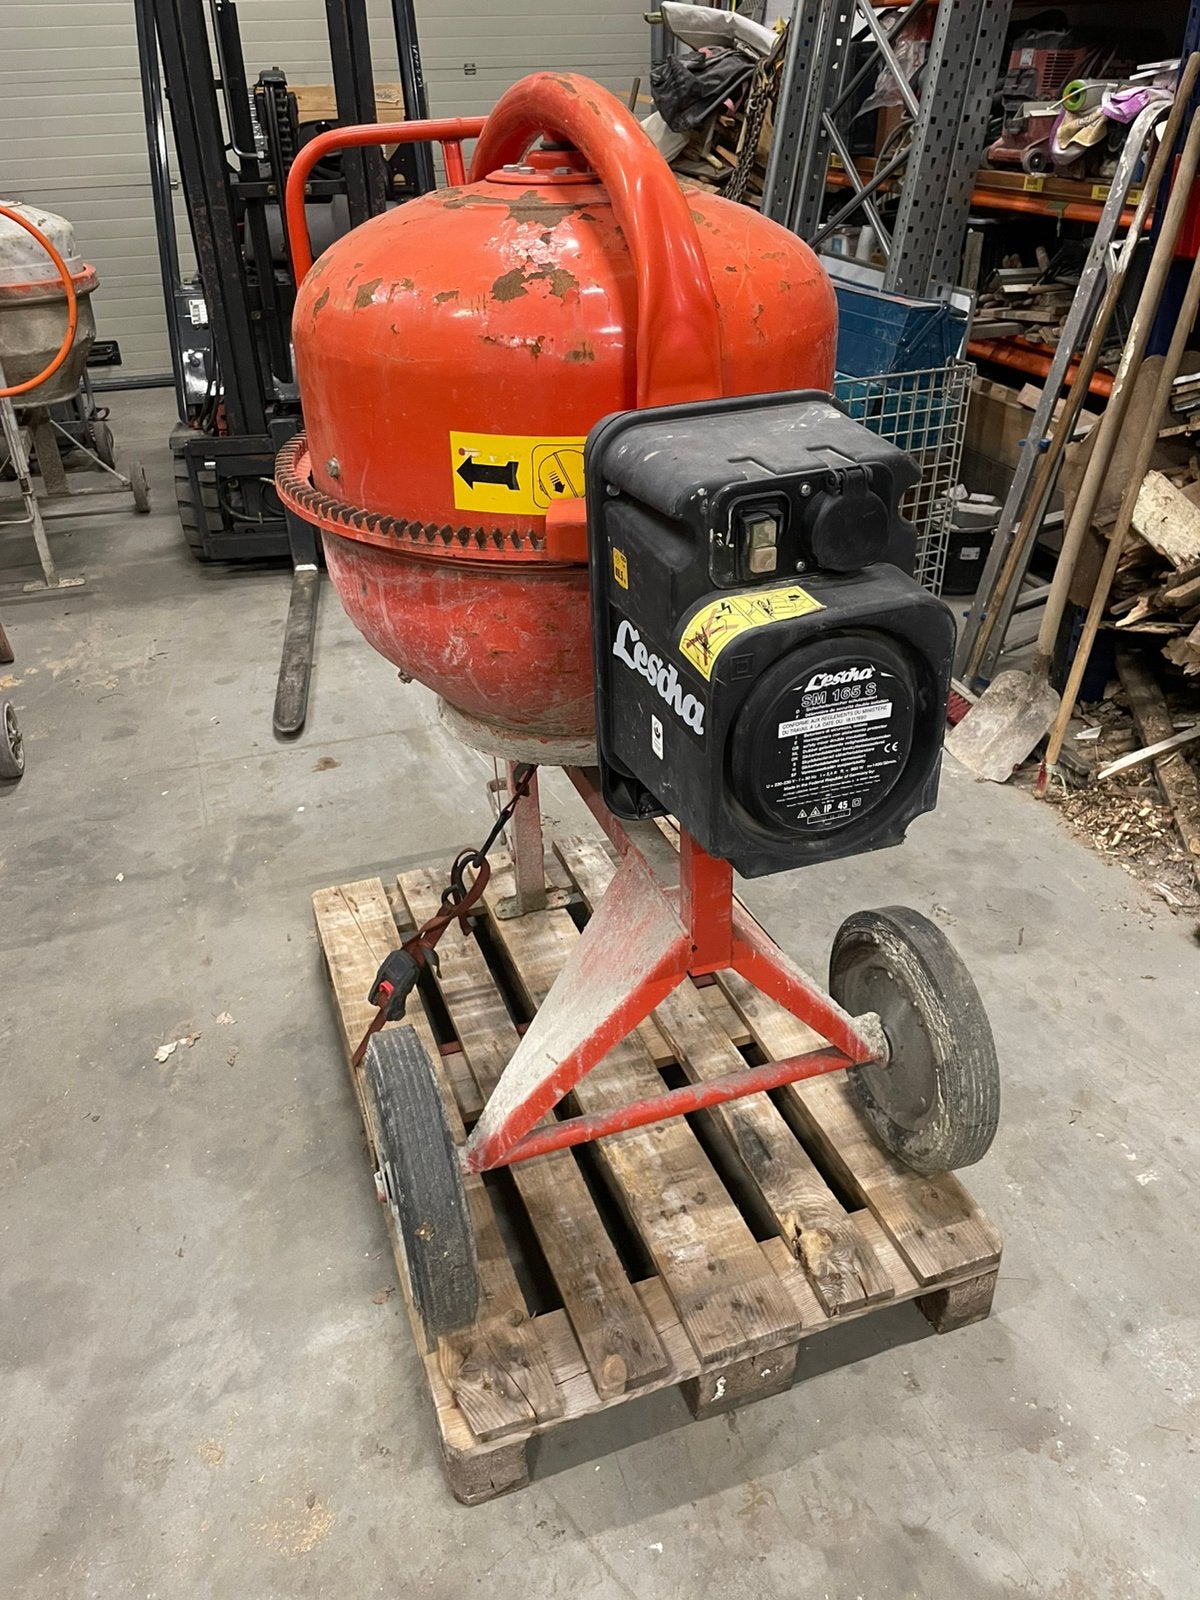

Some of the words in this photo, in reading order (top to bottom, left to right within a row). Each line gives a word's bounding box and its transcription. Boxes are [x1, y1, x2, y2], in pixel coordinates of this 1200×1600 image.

[613, 620, 705, 735] Lescha
[804, 666, 873, 692] Lescha
[801, 691, 827, 707] SM
[832, 685, 861, 701] 165
[865, 682, 877, 696] S
[823, 804, 832, 813] IP
[837, 801, 848, 810] 45
